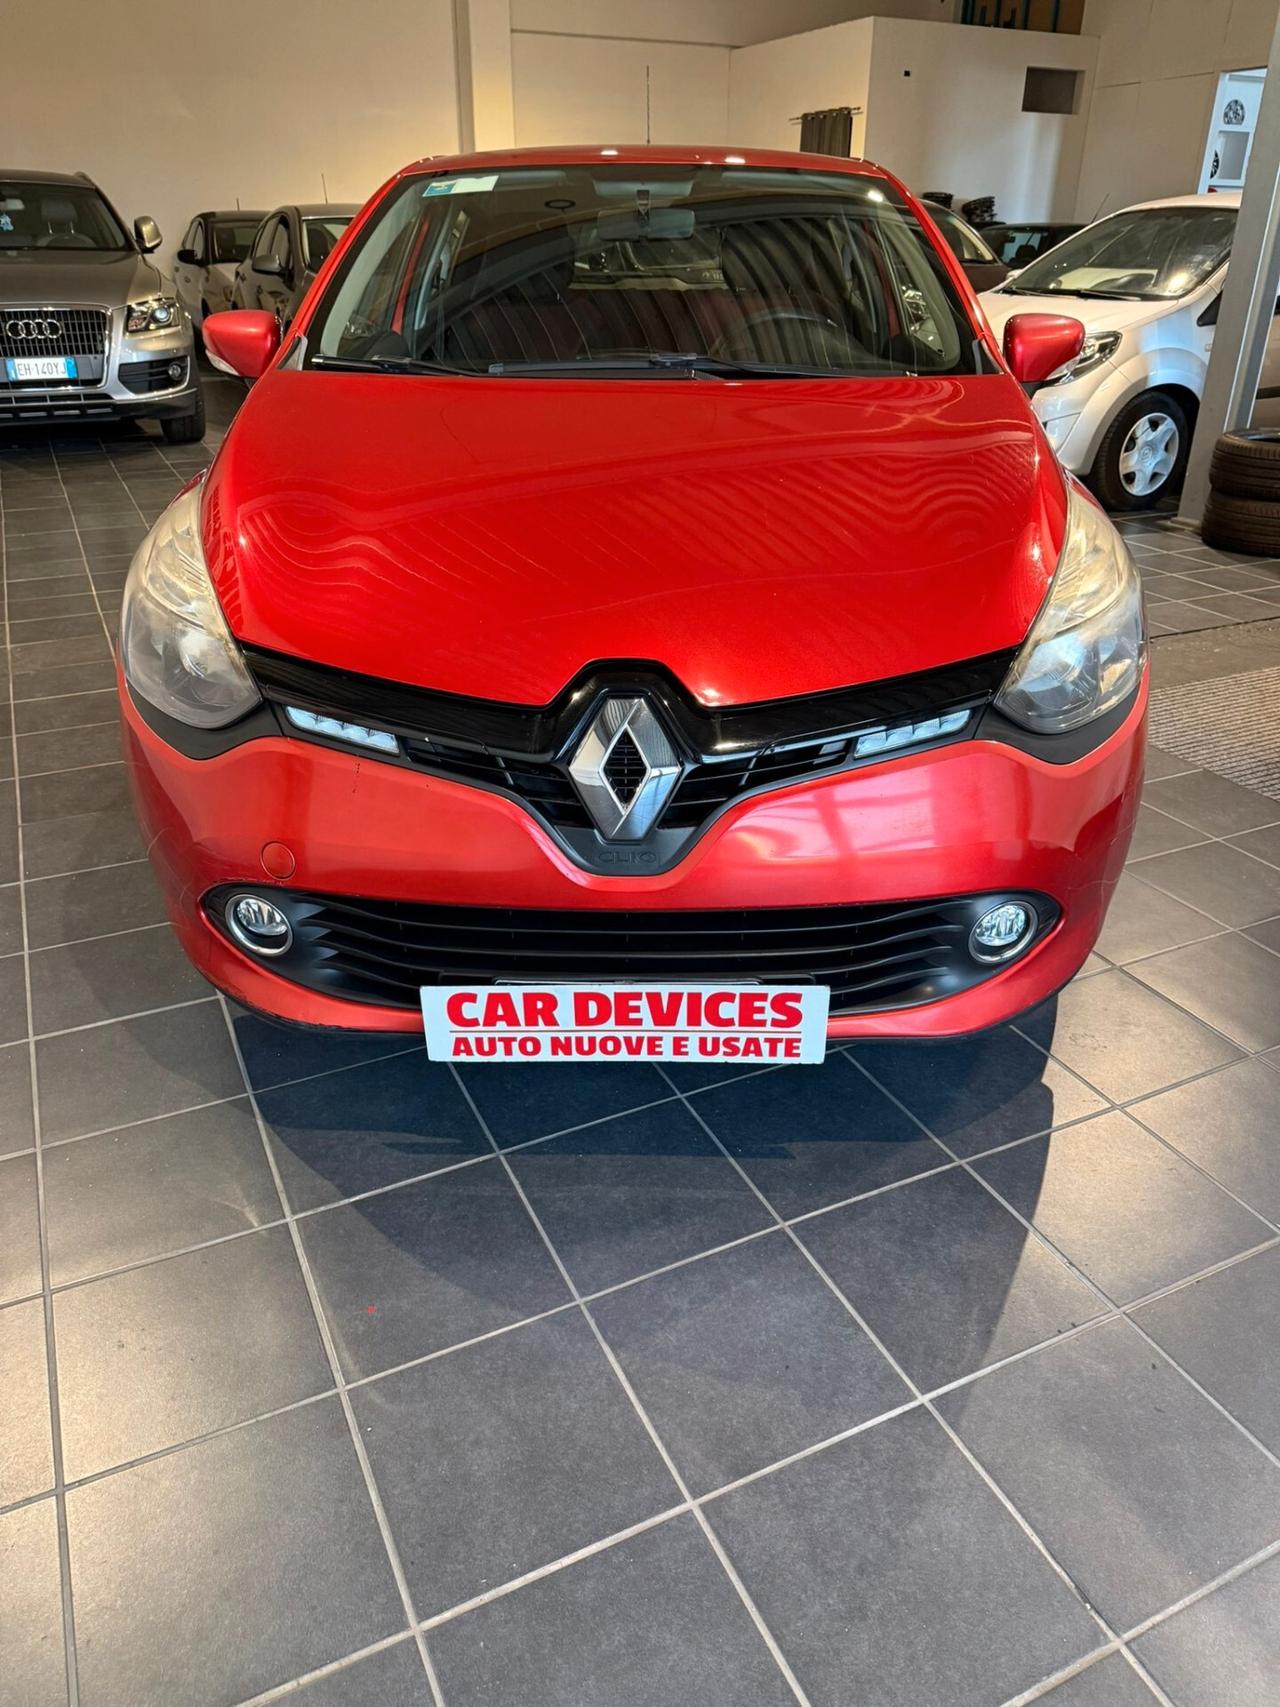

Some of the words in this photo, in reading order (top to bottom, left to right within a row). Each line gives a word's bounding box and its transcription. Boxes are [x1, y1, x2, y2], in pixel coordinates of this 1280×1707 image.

[599, 851, 657, 864] CLIO
[447, 992, 560, 1028] CAR
[573, 991, 803, 1029] DEVICES
[452, 1036, 541, 1057] AUTO
[551, 1035, 663, 1057] NUOVE
[672, 1036, 689, 1056] E
[698, 1036, 802, 1058] USATE
